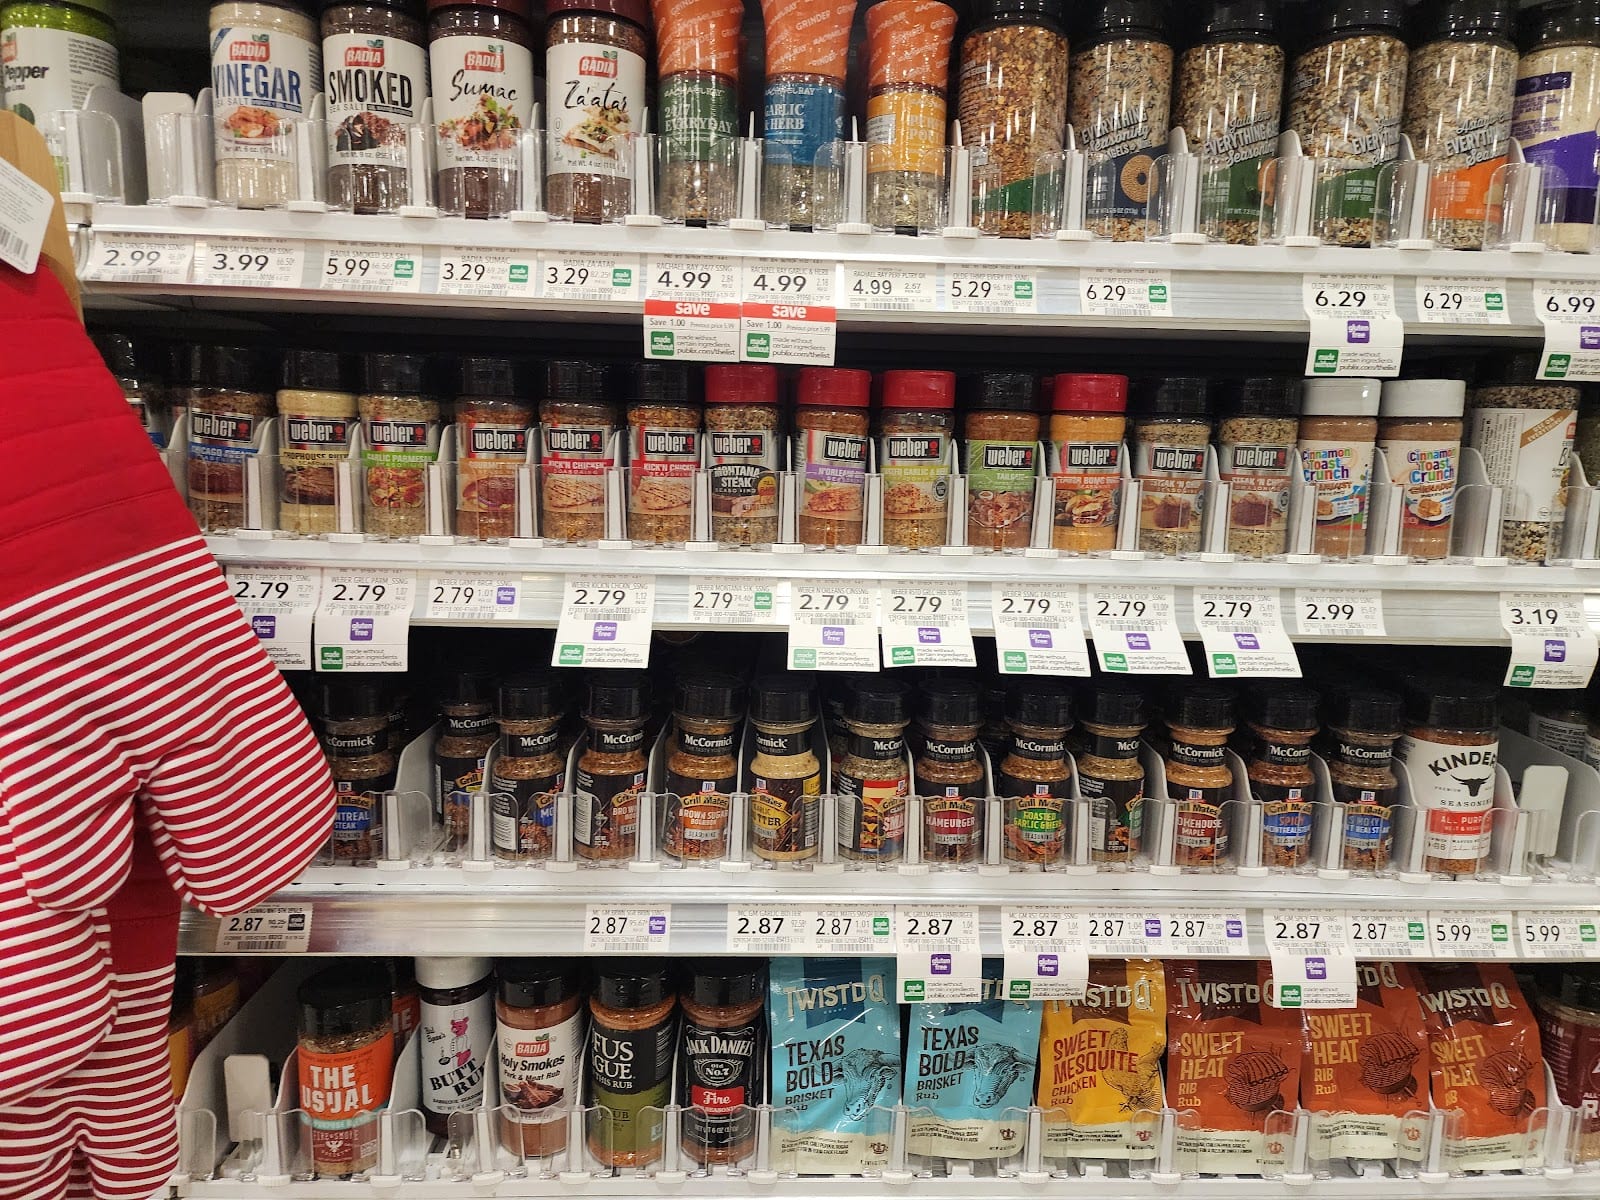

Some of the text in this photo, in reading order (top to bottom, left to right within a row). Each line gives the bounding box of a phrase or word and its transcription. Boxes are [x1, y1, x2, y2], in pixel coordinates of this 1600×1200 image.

[231, 44, 267, 59] BADIA
[346, 50, 381, 64] BADIA
[466, 53, 501, 69] BADIA
[581, 59, 614, 74] BADIA
[213, 63, 302, 104] VINEGAR
[329, 69, 413, 109] SMOKED
[450, 69, 518, 102] Sumac
[665, 116, 734, 134] EVERYDAY
[772, 119, 804, 130] HERB
[1081, 107, 1148, 145] EVERYTHING
[104, 249, 161, 266] 2.99
[212, 253, 269, 272] 3.99
[325, 257, 370, 277] 5.99
[442, 262, 486, 281] 3.29
[546, 266, 589, 285] 3.29
[656, 263, 686, 271] RACHAEL
[687, 263, 697, 271] RAY
[751, 266, 809, 275] RACHAEL GARLIC
[657, 271, 711, 289] 4.99
[753, 274, 807, 292] 4.99
[852, 279, 892, 295] 4.99
[951, 280, 992, 298] 5.29
[1086, 284, 1126, 301] 6.29
[1315, 290, 1366, 307] 6.29
[1423, 292, 1462, 310] 6.29
[1546, 296, 1595, 313] 6.99
[674, 302, 711, 317] save
[771, 305, 808, 319] save
[650, 318, 667, 326] Save
[747, 320, 782, 329] Save 1.00
[194, 415, 236, 437] weber
[291, 422, 333, 441] weber
[372, 422, 414, 441] weber
[475, 432, 516, 450] weber
[551, 432, 592, 450] weber
[647, 435, 686, 453] weber
[714, 436, 751, 454] weber
[828, 439, 862, 458] weber
[890, 438, 928, 457] weber
[987, 447, 1025, 467] weber
[1070, 446, 1110, 466] weber
[1156, 450, 1196, 469] weber
[1236, 446, 1277, 467] weber
[1308, 457, 1342, 470] Toast
[714, 466, 761, 479] MONTANA
[1419, 459, 1451, 471] Toast
[721, 476, 752, 488] STEAK
[1303, 467, 1350, 482] Crunch
[234, 582, 289, 599] 2.79
[332, 584, 386, 601] 2.79
[433, 586, 474, 604] 2.79
[573, 589, 626, 605] 2.79
[693, 591, 733, 609] 2.79
[799, 594, 849, 610] 2.79
[893, 596, 942, 612] 2.79
[1001, 598, 1050, 614] 2.79
[1097, 601, 1146, 617] 2.79
[1203, 601, 1253, 618] 2.79
[1306, 603, 1355, 620] 2.99
[1510, 608, 1558, 625] 3.19
[926, 740, 976, 754] McCormick
[1015, 737, 1064, 752] McCormick
[1173, 742, 1224, 758] McCormick
[1340, 744, 1392, 759] McCormick
[928, 800, 973, 811] Grill Mates
[1192, 803, 1218, 816] Mates
[229, 917, 263, 932] 2.87
[590, 916, 628, 935] 2.87
[737, 917, 784, 935] 2.87
[815, 918, 852, 936] 2.87
[907, 918, 953, 936] 2.87
[1013, 920, 1058, 937] 2.87
[1089, 920, 1124, 937] 2.87
[1170, 920, 1205, 938] 2.87
[1276, 923, 1320, 939] 2.87
[1352, 923, 1387, 940] 2.87
[1436, 924, 1471, 941] 5.99
[1525, 925, 1560, 942] 5.99
[868, 974, 889, 1005] Q
[1491, 982, 1517, 1010] Q
[1309, 1012, 1373, 1039] SWEET
[921, 1025, 979, 1051] TEXAS
[1053, 1029, 1112, 1060] SWEET
[1181, 1031, 1245, 1057] SWEET
[517, 1043, 547, 1055] BADIA
[785, 1035, 845, 1067] TEXAS
[1313, 1038, 1360, 1066] HEAT
[1431, 1034, 1487, 1064] SWEET
[520, 1054, 566, 1072] Smokes
[919, 1050, 966, 1077] BOLD
[1053, 1050, 1139, 1085] MESQUITE
[1180, 1056, 1228, 1081] HEAT
[310, 1064, 357, 1090] THE
[430, 1058, 477, 1091] BUTT
[546, 1069, 561, 1080] Rub
[786, 1061, 833, 1093] BOLD
[917, 1072, 962, 1091] BRISKET
[1314, 1067, 1334, 1082] RIB
[612, 1081, 633, 1089] RUB
[1051, 1075, 1097, 1096] CHICKEN
[1178, 1082, 1197, 1096] RIB
[1315, 1083, 1337, 1095] Rub
[302, 1084, 373, 1114] USUAL
[703, 1091, 731, 1105] Fire
[785, 1088, 835, 1105] BRISKET
[916, 1090, 939, 1102] Rub
[1050, 1095, 1074, 1107] Rub
[1177, 1095, 1201, 1107] Rub
